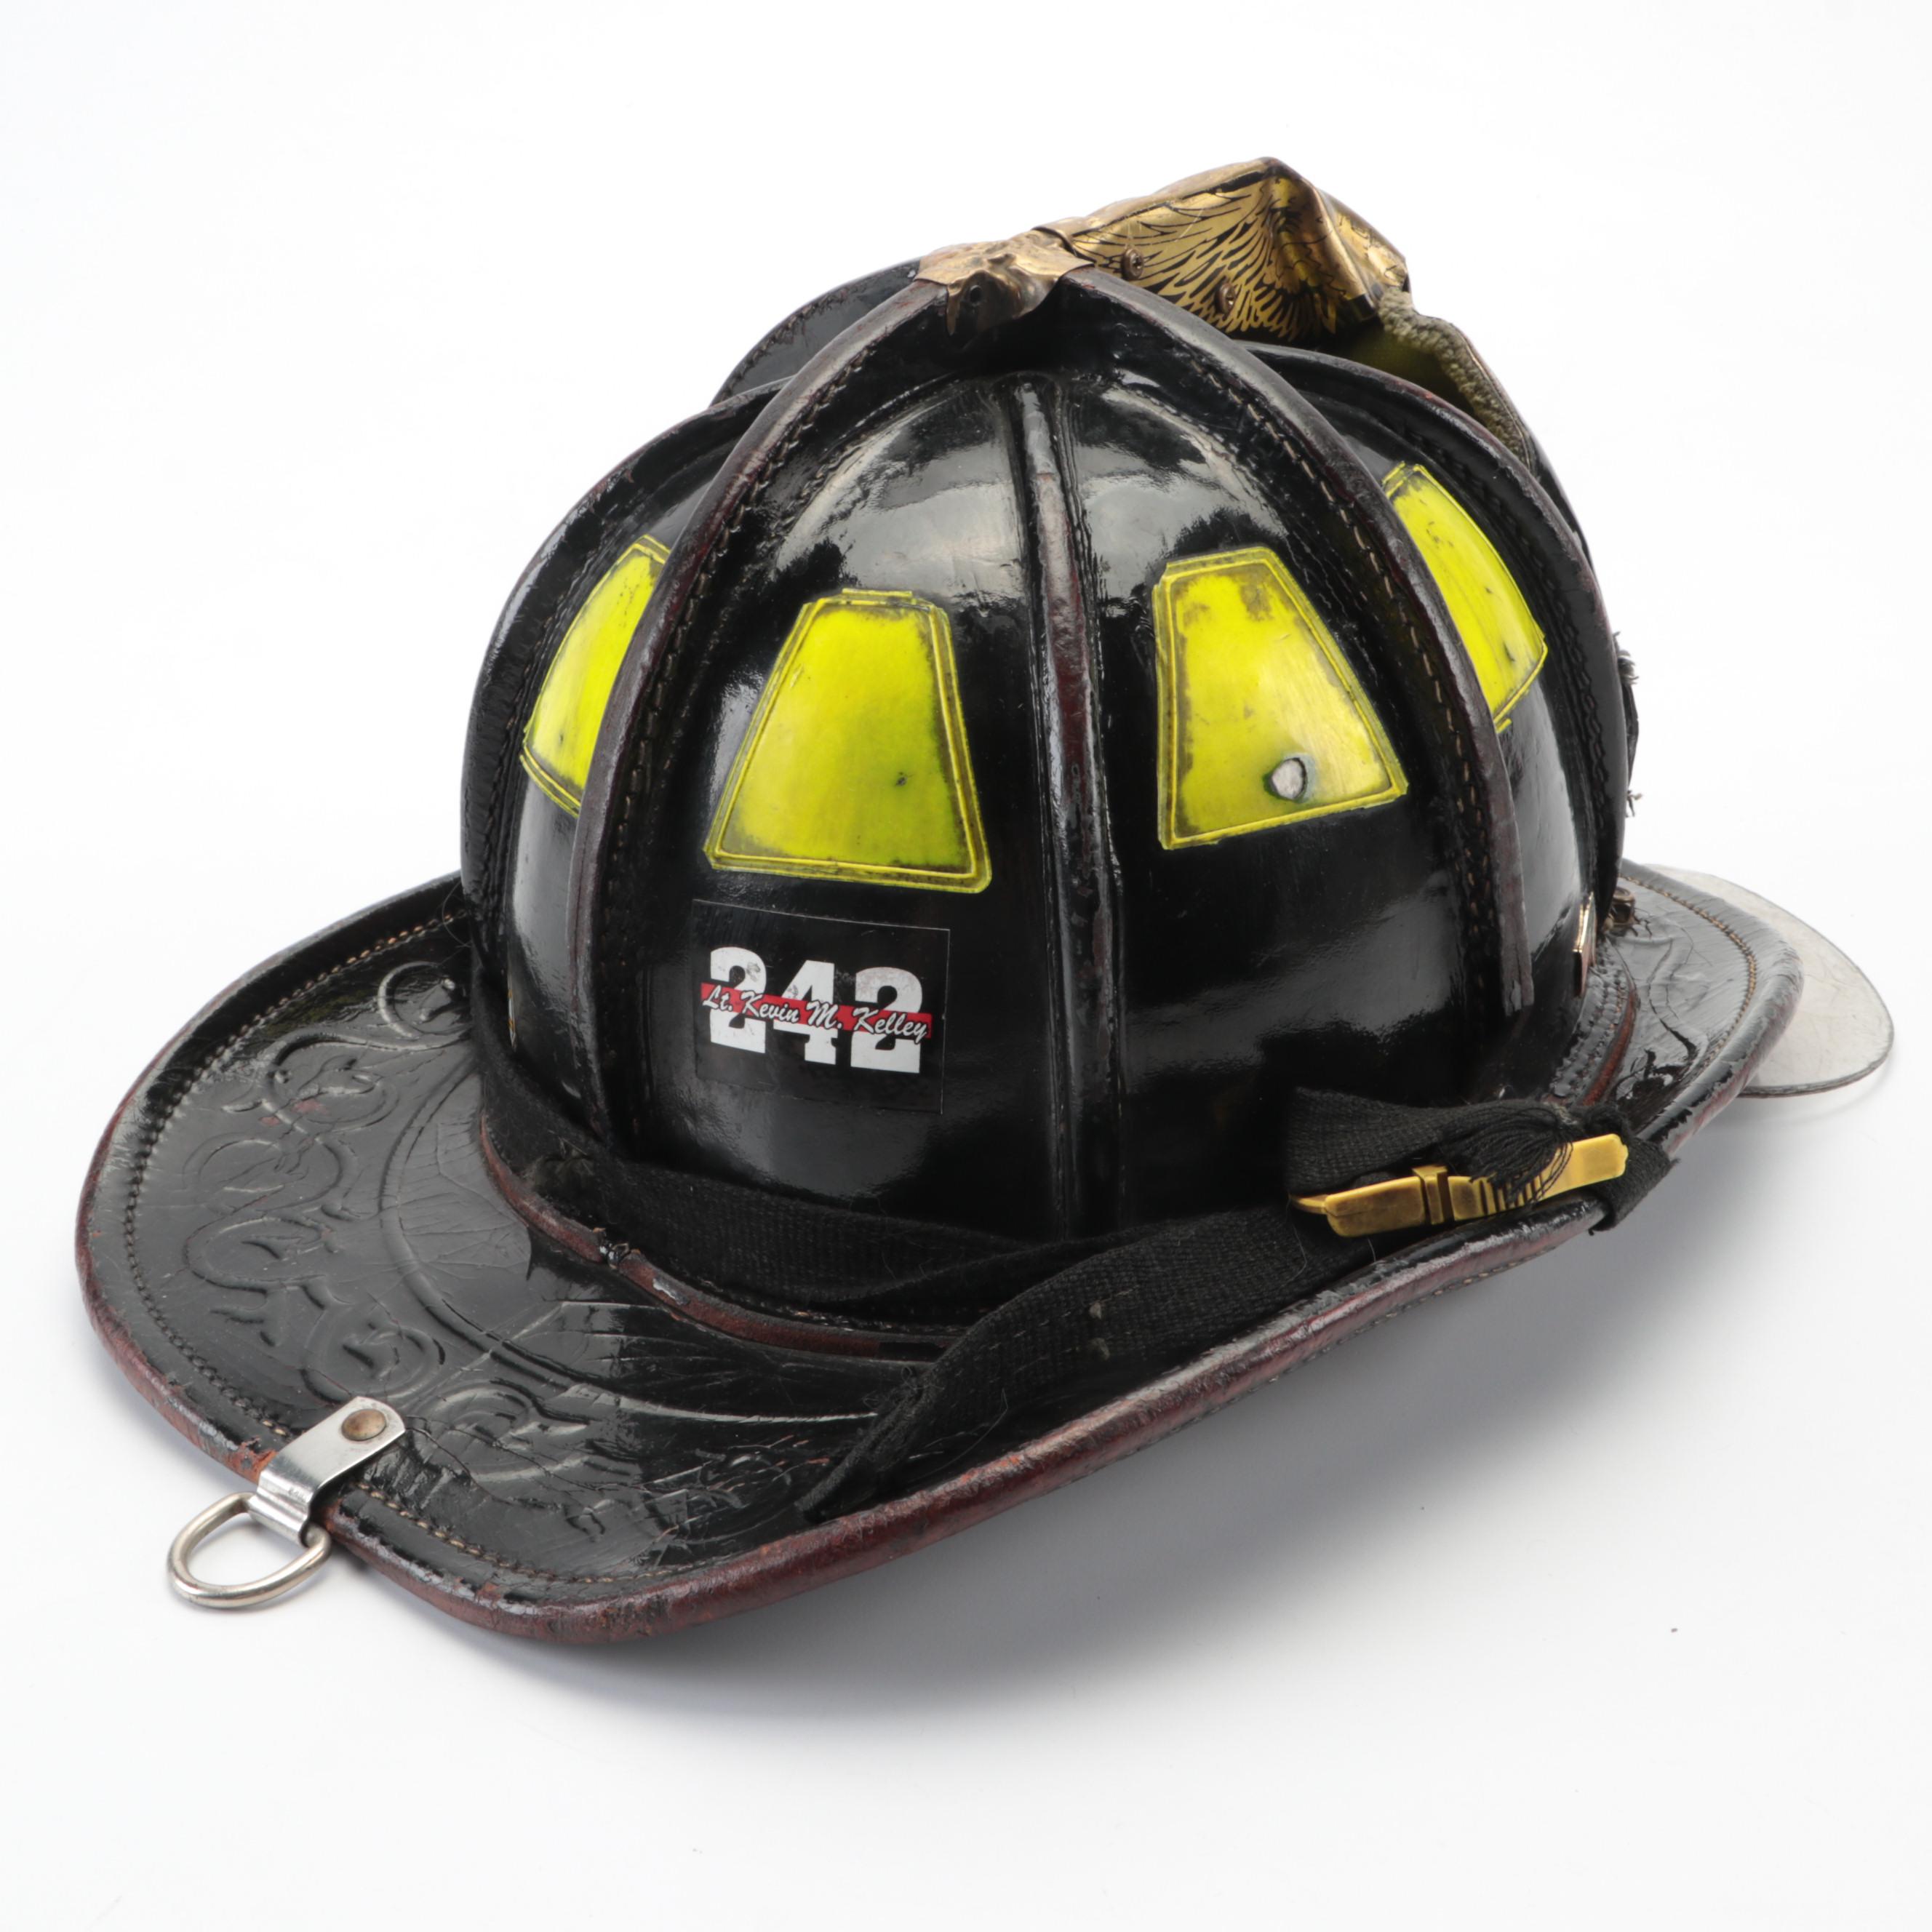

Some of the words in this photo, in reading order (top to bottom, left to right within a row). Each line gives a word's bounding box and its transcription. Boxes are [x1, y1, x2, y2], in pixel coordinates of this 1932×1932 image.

[703, 985, 733, 1012] Lt.
[741, 991, 799, 1023] Kevin
[806, 1001, 843, 1029] M.
[853, 1007, 928, 1043] Kelley
[710, 946, 922, 1074] 242
